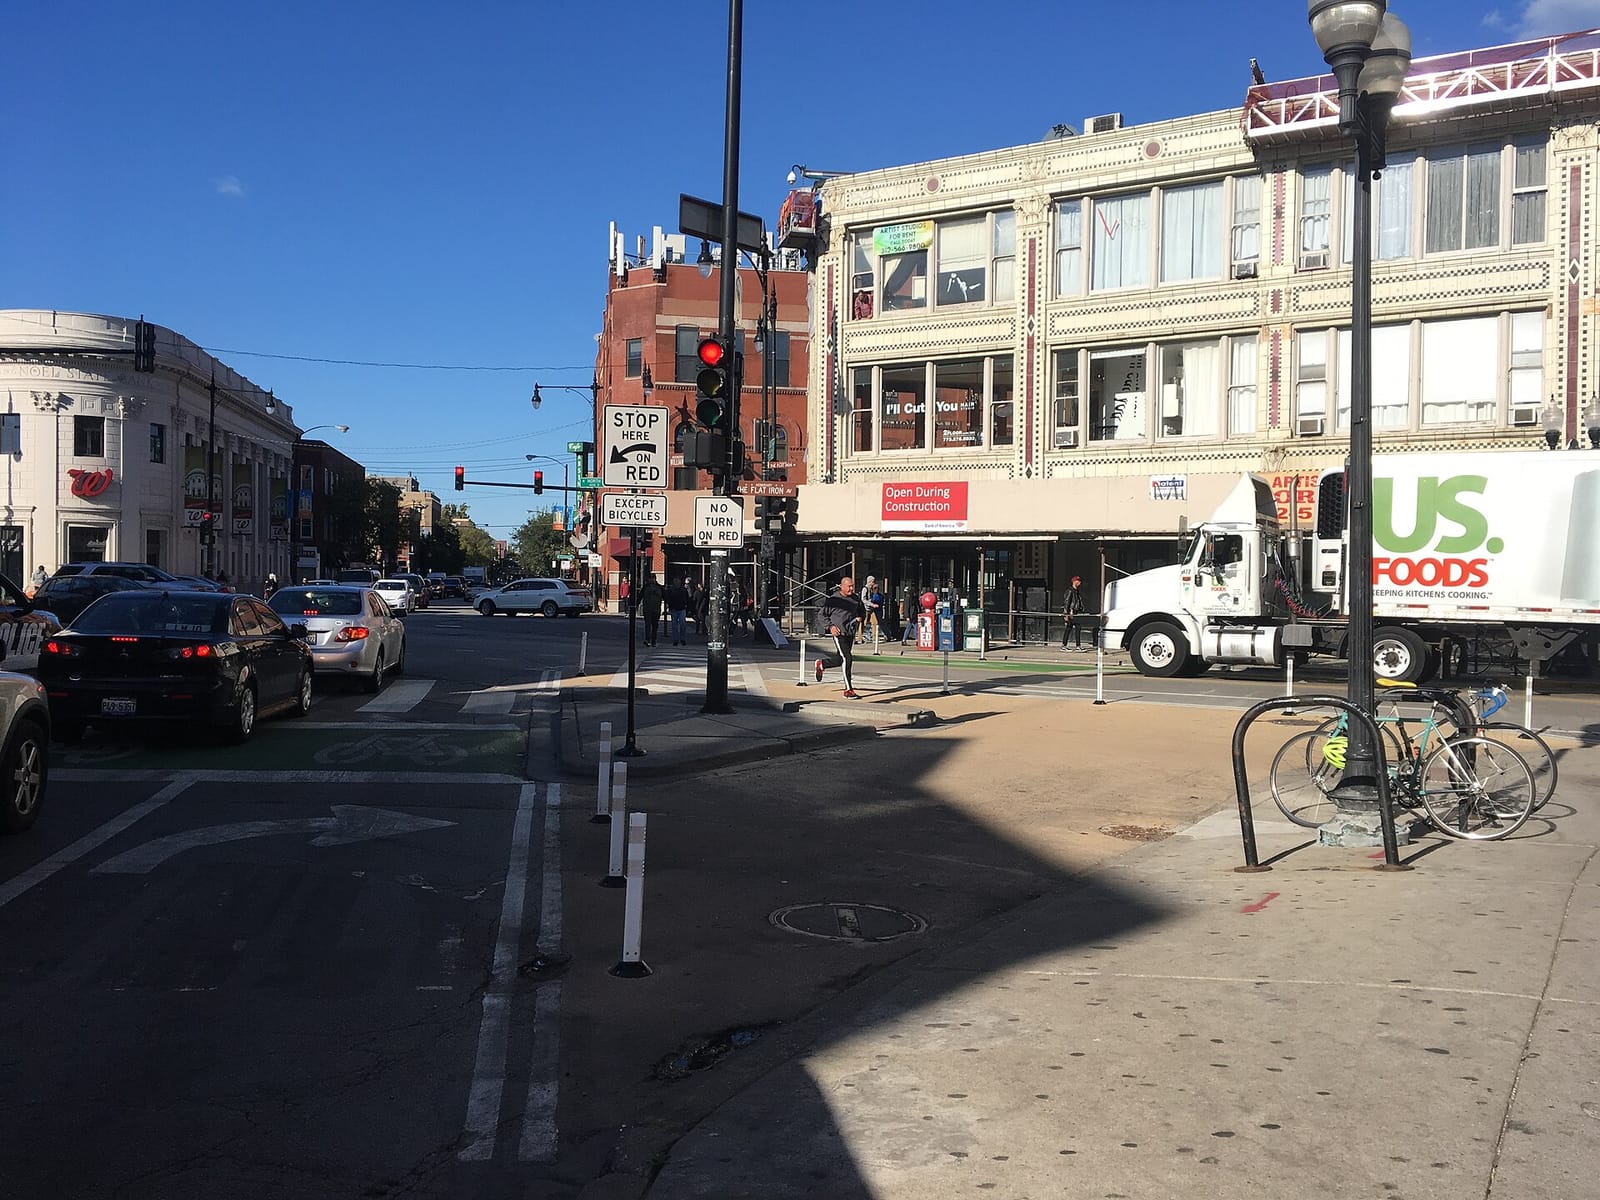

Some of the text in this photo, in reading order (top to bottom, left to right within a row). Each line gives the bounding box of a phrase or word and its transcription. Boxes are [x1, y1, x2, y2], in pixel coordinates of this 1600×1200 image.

[880, 223, 926, 234] ARTIST STUDIOS
[19, 366, 60, 378] NOEL
[886, 403, 900, 415] I'll
[904, 402, 926, 415] Cut
[936, 401, 958, 413] You
[614, 412, 659, 429] STOP
[622, 430, 650, 441] HERE
[636, 453, 651, 463] ON
[626, 465, 660, 481] RED
[769, 487, 784, 495] IRON
[886, 486, 950, 500] Open During
[615, 498, 655, 509] EXCEPT
[710, 503, 728, 513] NO
[885, 501, 950, 512] Construction
[608, 510, 661, 521] BICYCLES
[1373, 475, 1505, 554] US.
[705, 517, 733, 527] TURN
[698, 531, 739, 541] ON RED
[1373, 557, 1489, 588] FOODS
[1405, 590, 1446, 599] KITCHENS
[0, 622, 46, 656] OLICE
